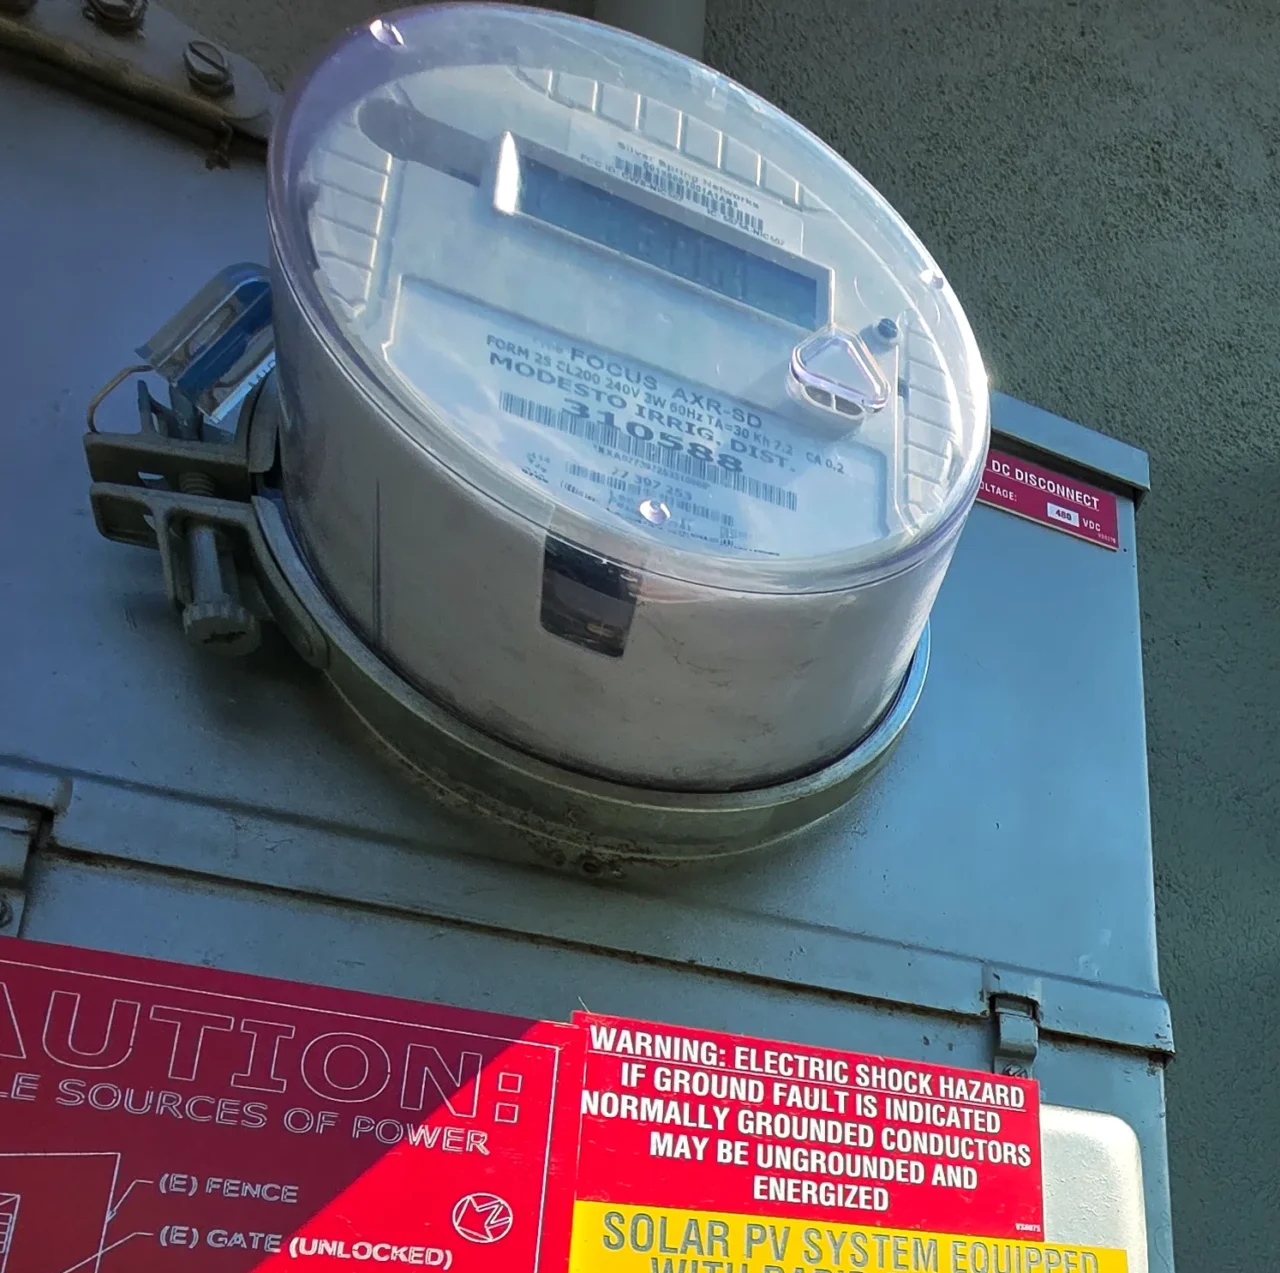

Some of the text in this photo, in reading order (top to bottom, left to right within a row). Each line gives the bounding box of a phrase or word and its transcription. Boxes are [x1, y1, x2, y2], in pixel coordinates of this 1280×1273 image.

[703, 177, 760, 210] Networks
[487, 334, 703, 423] FORM CL200 240V 60Hz
[490, 352, 628, 411] MODESTO
[633, 404, 722, 447] IRRIG.
[729, 436, 796, 473] DIST.
[571, 347, 762, 430] FOCUS AXR-SD
[562, 398, 743, 474] 310588
[991, 459, 1100, 511] DC DISCONNECT
[589, 1025, 1025, 1109] WARNING: ELECTRIC SHOCK HAZARD
[621, 1063, 1001, 1134] IF GROUND FAULT IS INDICATED
[55, 1078, 491, 1157] SOURCES OF POWER
[581, 1091, 1032, 1168] NORMALLY GROUNDED CONDUCTORS
[159, 1172, 299, 1203] (E) FENCE
[649, 1130, 978, 1190] MAY BE UNGROUNDED AND
[753, 1174, 890, 1211] ENERGIZED
[159, 1226, 454, 1271] (E) GATE (UNLOCKED)
[602, 1211, 730, 1258] SOLAR
[743, 1224, 792, 1262] PV
[803, 1231, 938, 1273] SYSTEM
